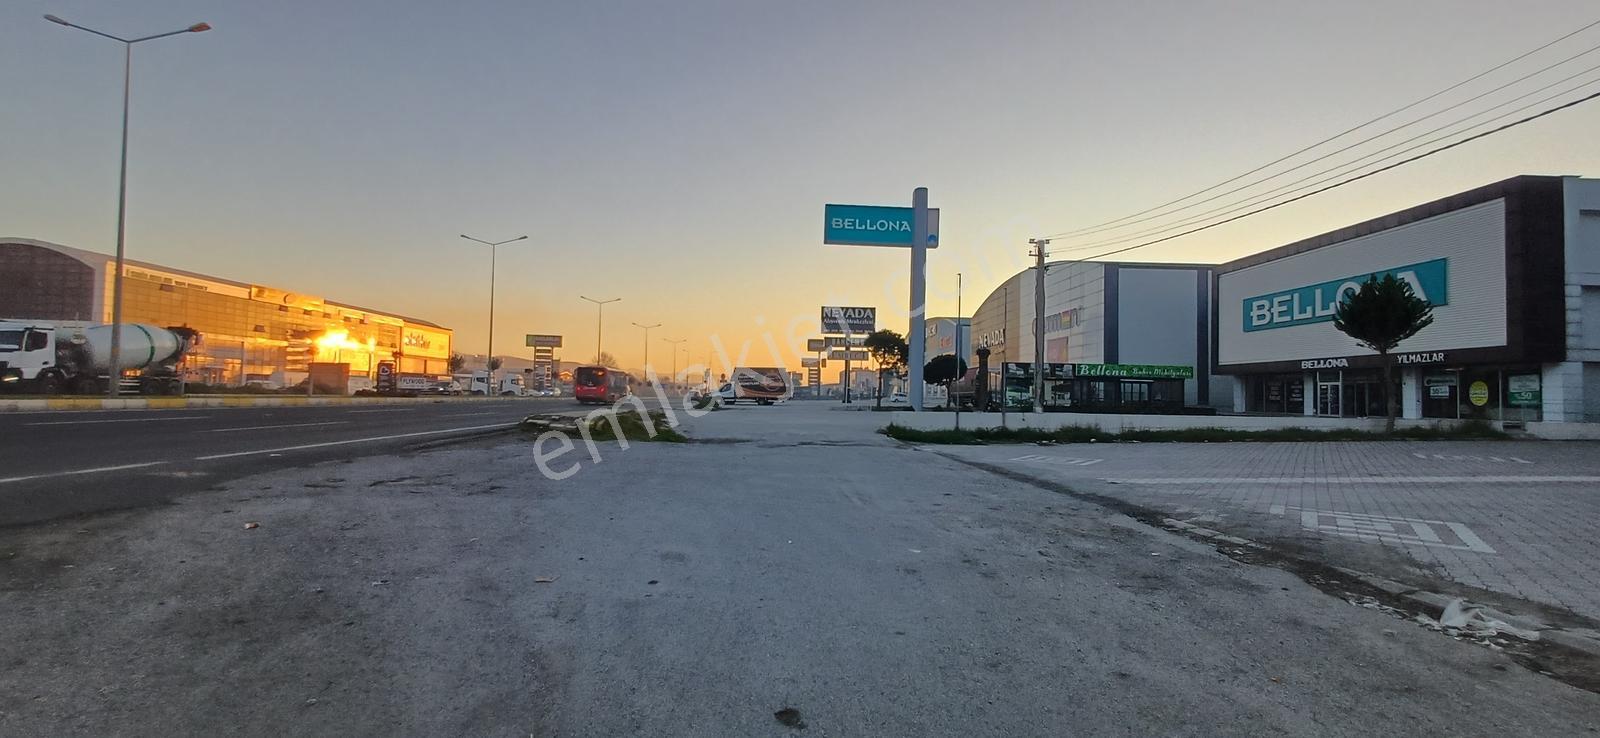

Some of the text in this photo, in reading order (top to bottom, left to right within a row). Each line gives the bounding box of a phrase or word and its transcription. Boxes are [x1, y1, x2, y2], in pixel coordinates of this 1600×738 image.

[832, 217, 911, 232] BELLONA
[1250, 270, 1428, 326] BELLOA
[823, 307, 874, 319] NEVADA
[979, 328, 1005, 349] NEVADA
[1301, 353, 1444, 369] BELLONA YILMAZLAR
[1080, 364, 1127, 376] Bellona
